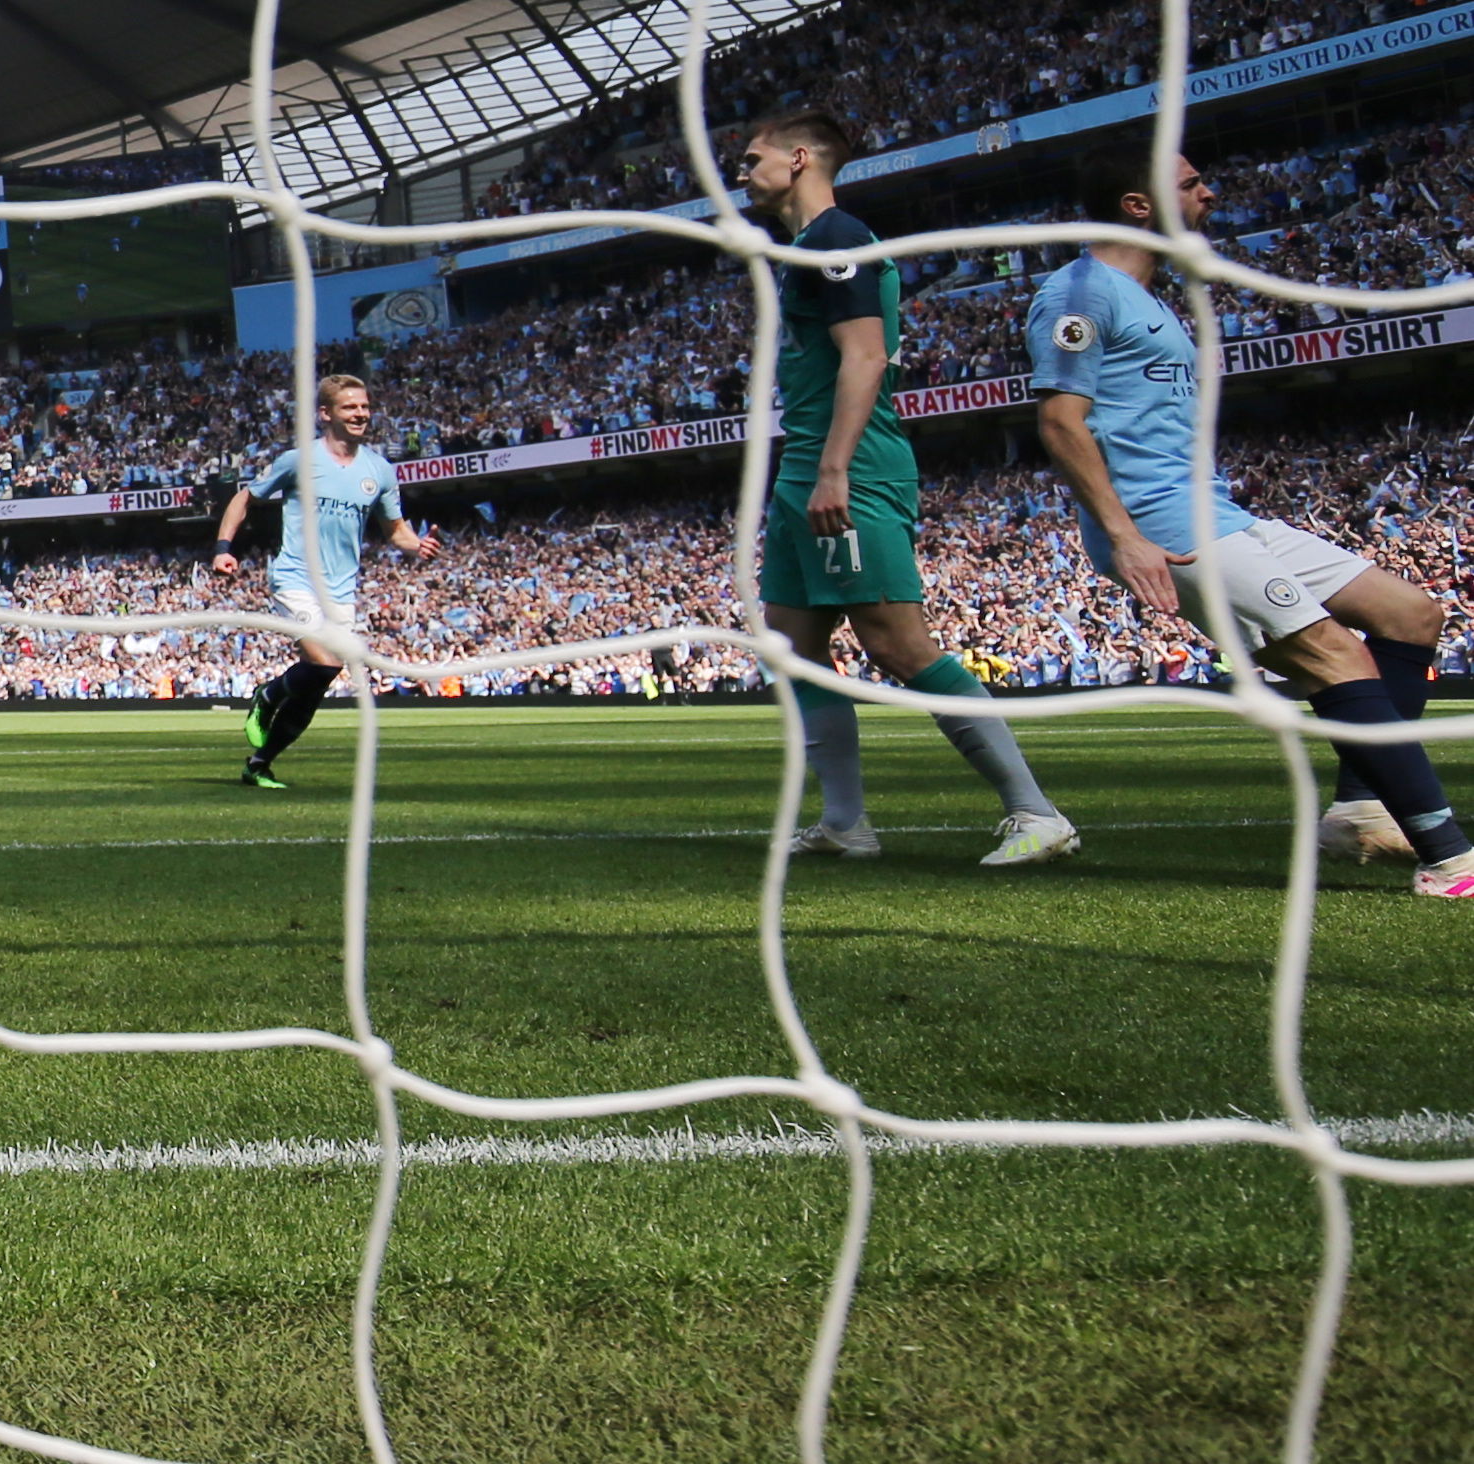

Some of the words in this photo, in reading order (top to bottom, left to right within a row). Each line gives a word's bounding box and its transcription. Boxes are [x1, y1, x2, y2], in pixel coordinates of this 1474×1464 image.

[1191, 74, 1219, 97] ON
[1222, 63, 1264, 89] THE
[1268, 46, 1331, 78] SIXTH
[1335, 35, 1379, 62] DAY
[1382, 22, 1432, 49] GOD
[1218, 313, 1445, 374] FINDMYSHIRT
[590, 416, 748, 459] #FINDMYSHIRT
[816, 529, 863, 574] 21
